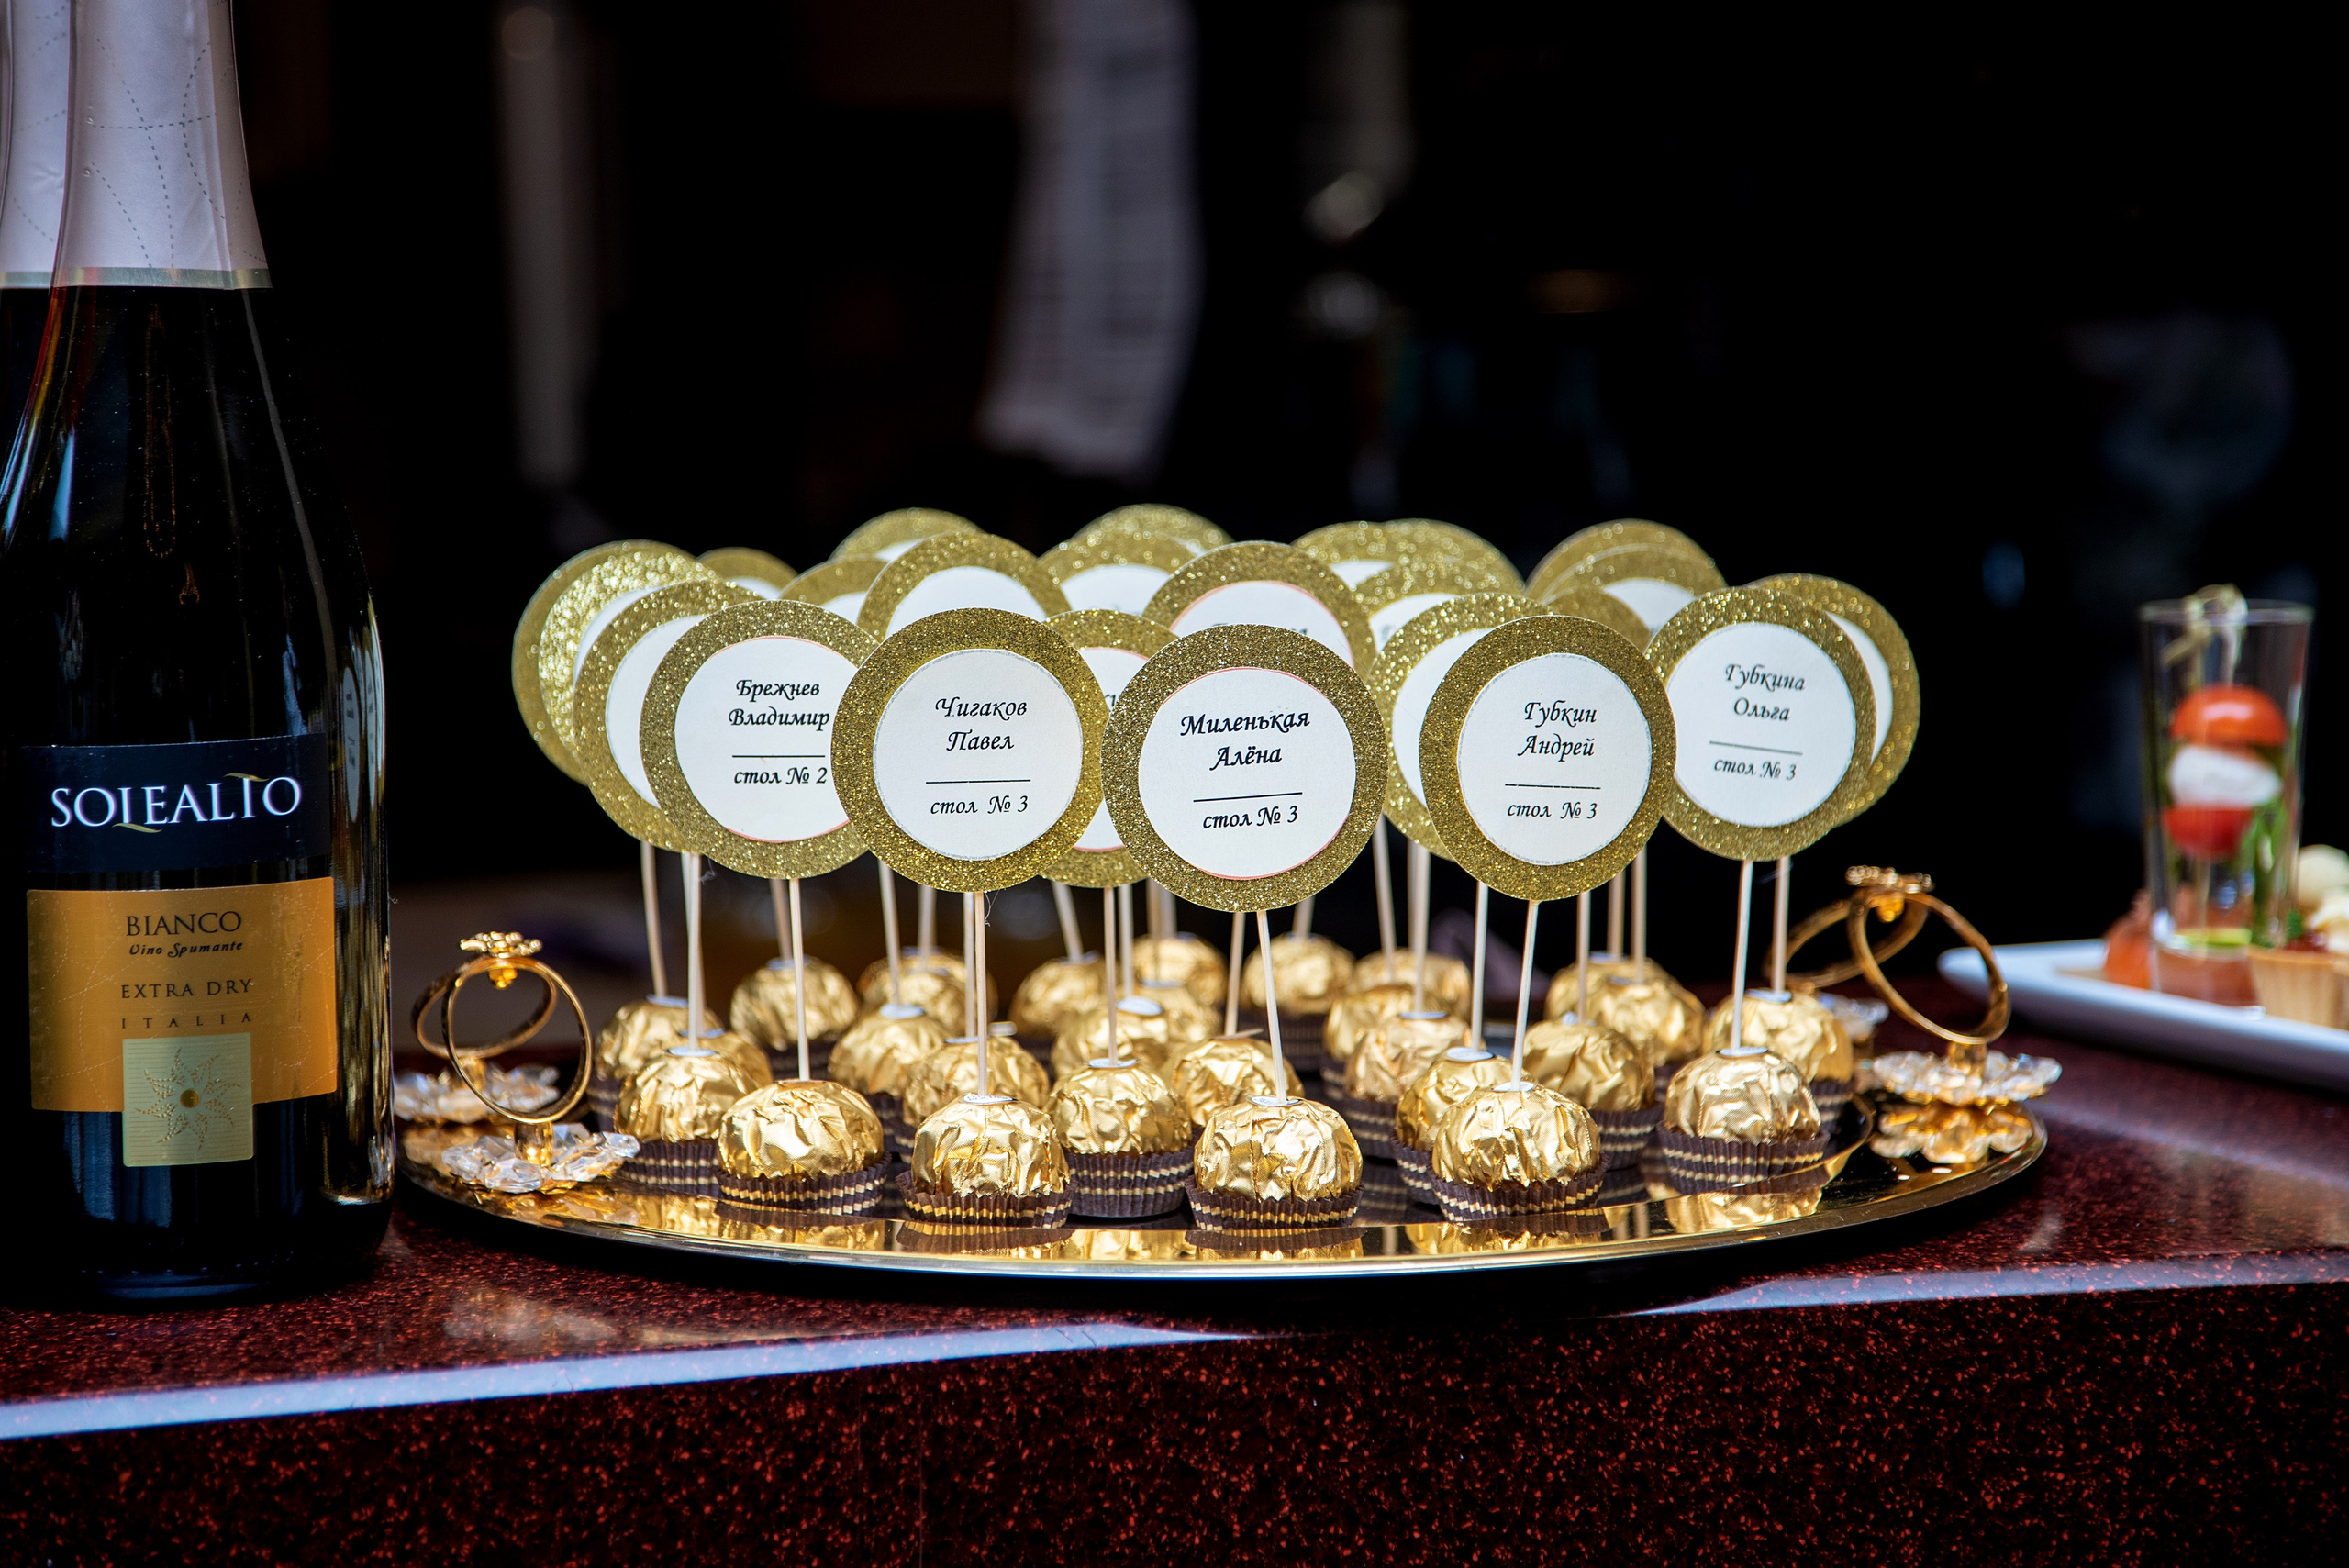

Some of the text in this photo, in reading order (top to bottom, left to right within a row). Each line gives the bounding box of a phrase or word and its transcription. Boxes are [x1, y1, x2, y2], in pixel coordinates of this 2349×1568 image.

[1724, 663, 1805, 692] Губкина
[736, 679, 820, 703] Брежнев
[728, 706, 830, 732] Владимир
[934, 696, 1028, 721] Чигаков
[1523, 699, 1598, 728] Губкин
[1733, 697, 1790, 721] Ольга
[1179, 711, 1311, 737] Миленькая
[945, 728, 1015, 751] Павел
[1516, 732, 1595, 761] Андрей
[1208, 745, 1283, 772] Алёна
[1713, 759, 1755, 775] стол
[1786, 763, 1798, 781] 3
[733, 771, 782, 784] стол
[816, 766, 828, 784] 2
[50, 773, 302, 833] SOLEALTO
[930, 801, 979, 815] стол
[1017, 795, 1029, 813] 3
[1507, 804, 1552, 818] стол
[1586, 802, 1598, 820] 3
[1202, 813, 1252, 829] стол
[1286, 805, 1299, 824] 3
[125, 910, 242, 937] BIANCO
[167, 940, 244, 959] Spumante
[120, 977, 253, 1000] EXTRA DRY
[120, 1011, 253, 1029] ITALIA
